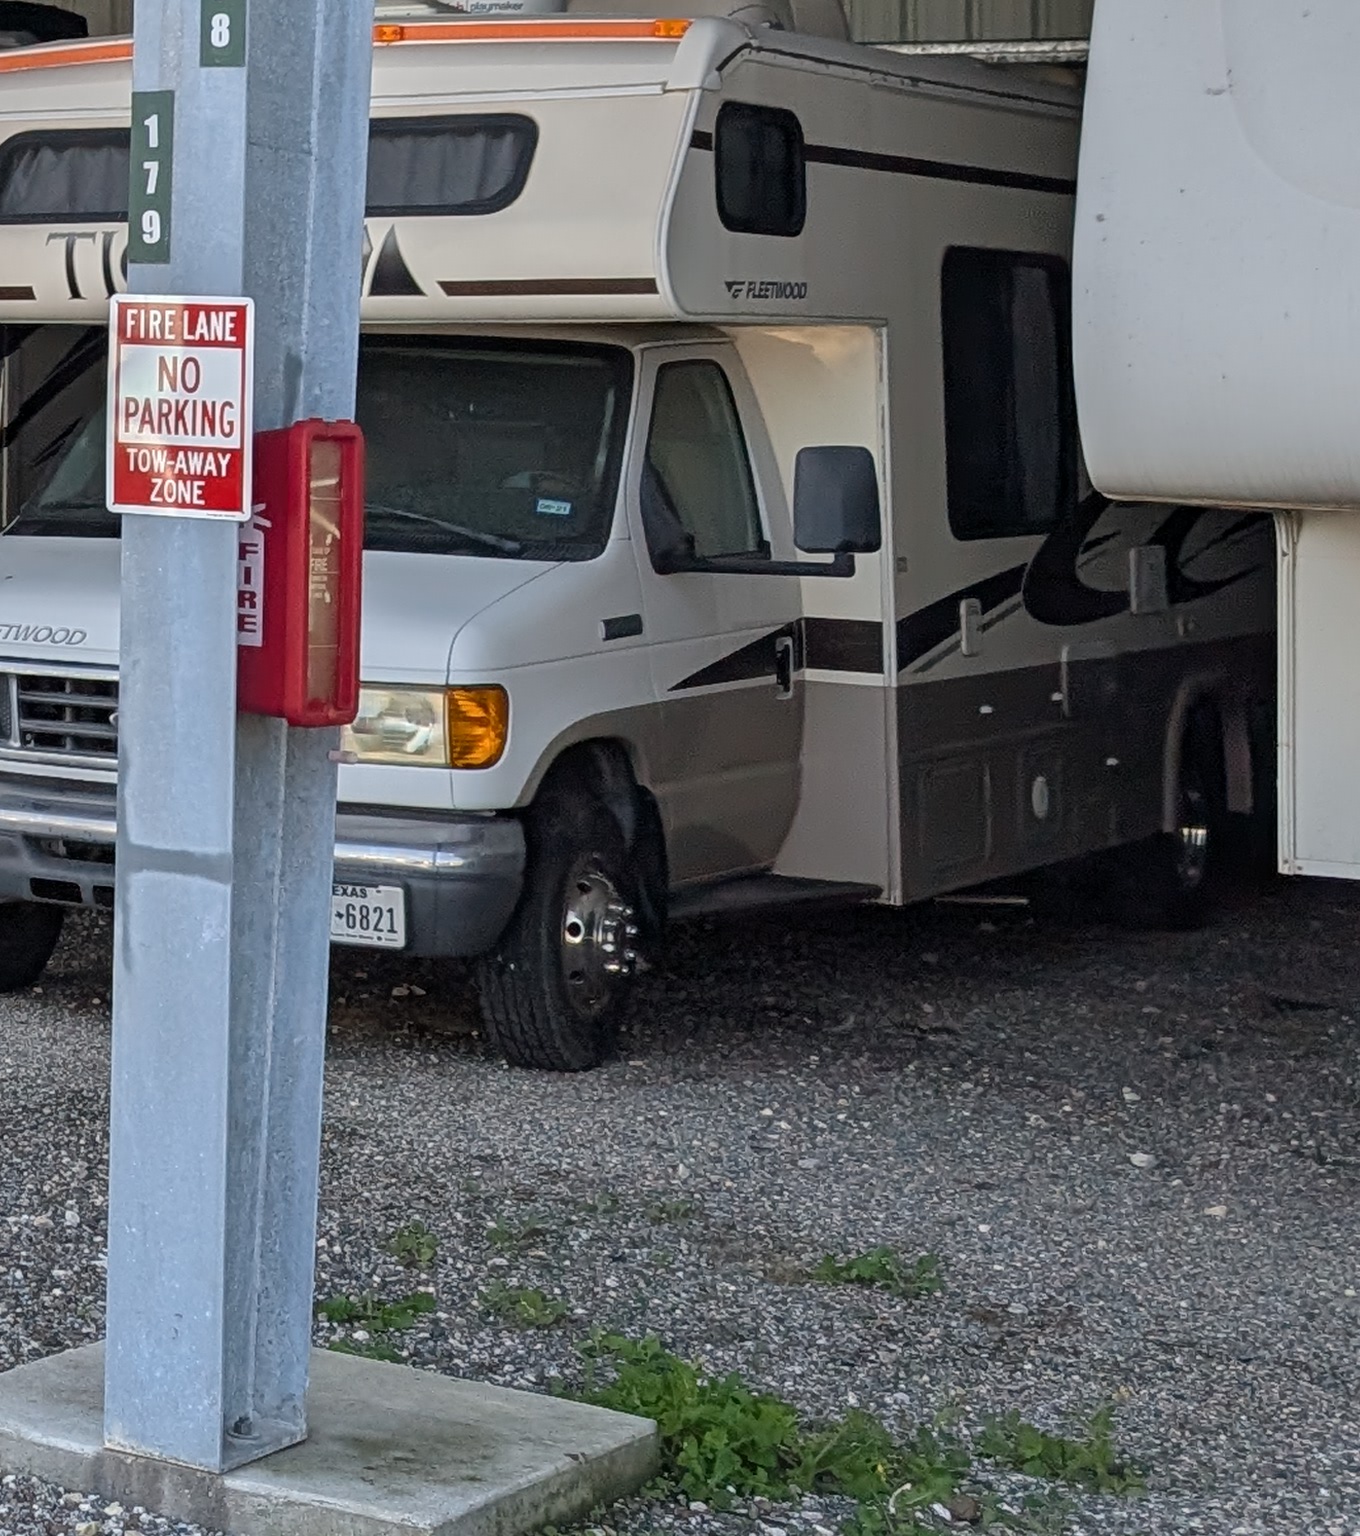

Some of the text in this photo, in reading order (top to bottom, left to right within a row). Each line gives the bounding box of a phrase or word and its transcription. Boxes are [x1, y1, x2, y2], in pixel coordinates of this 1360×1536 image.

[141, 114, 162, 244] 179
[746, 281, 808, 300] FLEETWOOD
[126, 309, 237, 342] FIRE LANE
[158, 355, 201, 394] NO
[124, 396, 235, 439] PARKING
[126, 447, 232, 478] TOW-AWAY
[150, 478, 206, 506] ZONE
[237, 542, 259, 633] FIRE
[332, 885, 368, 899] EXAS
